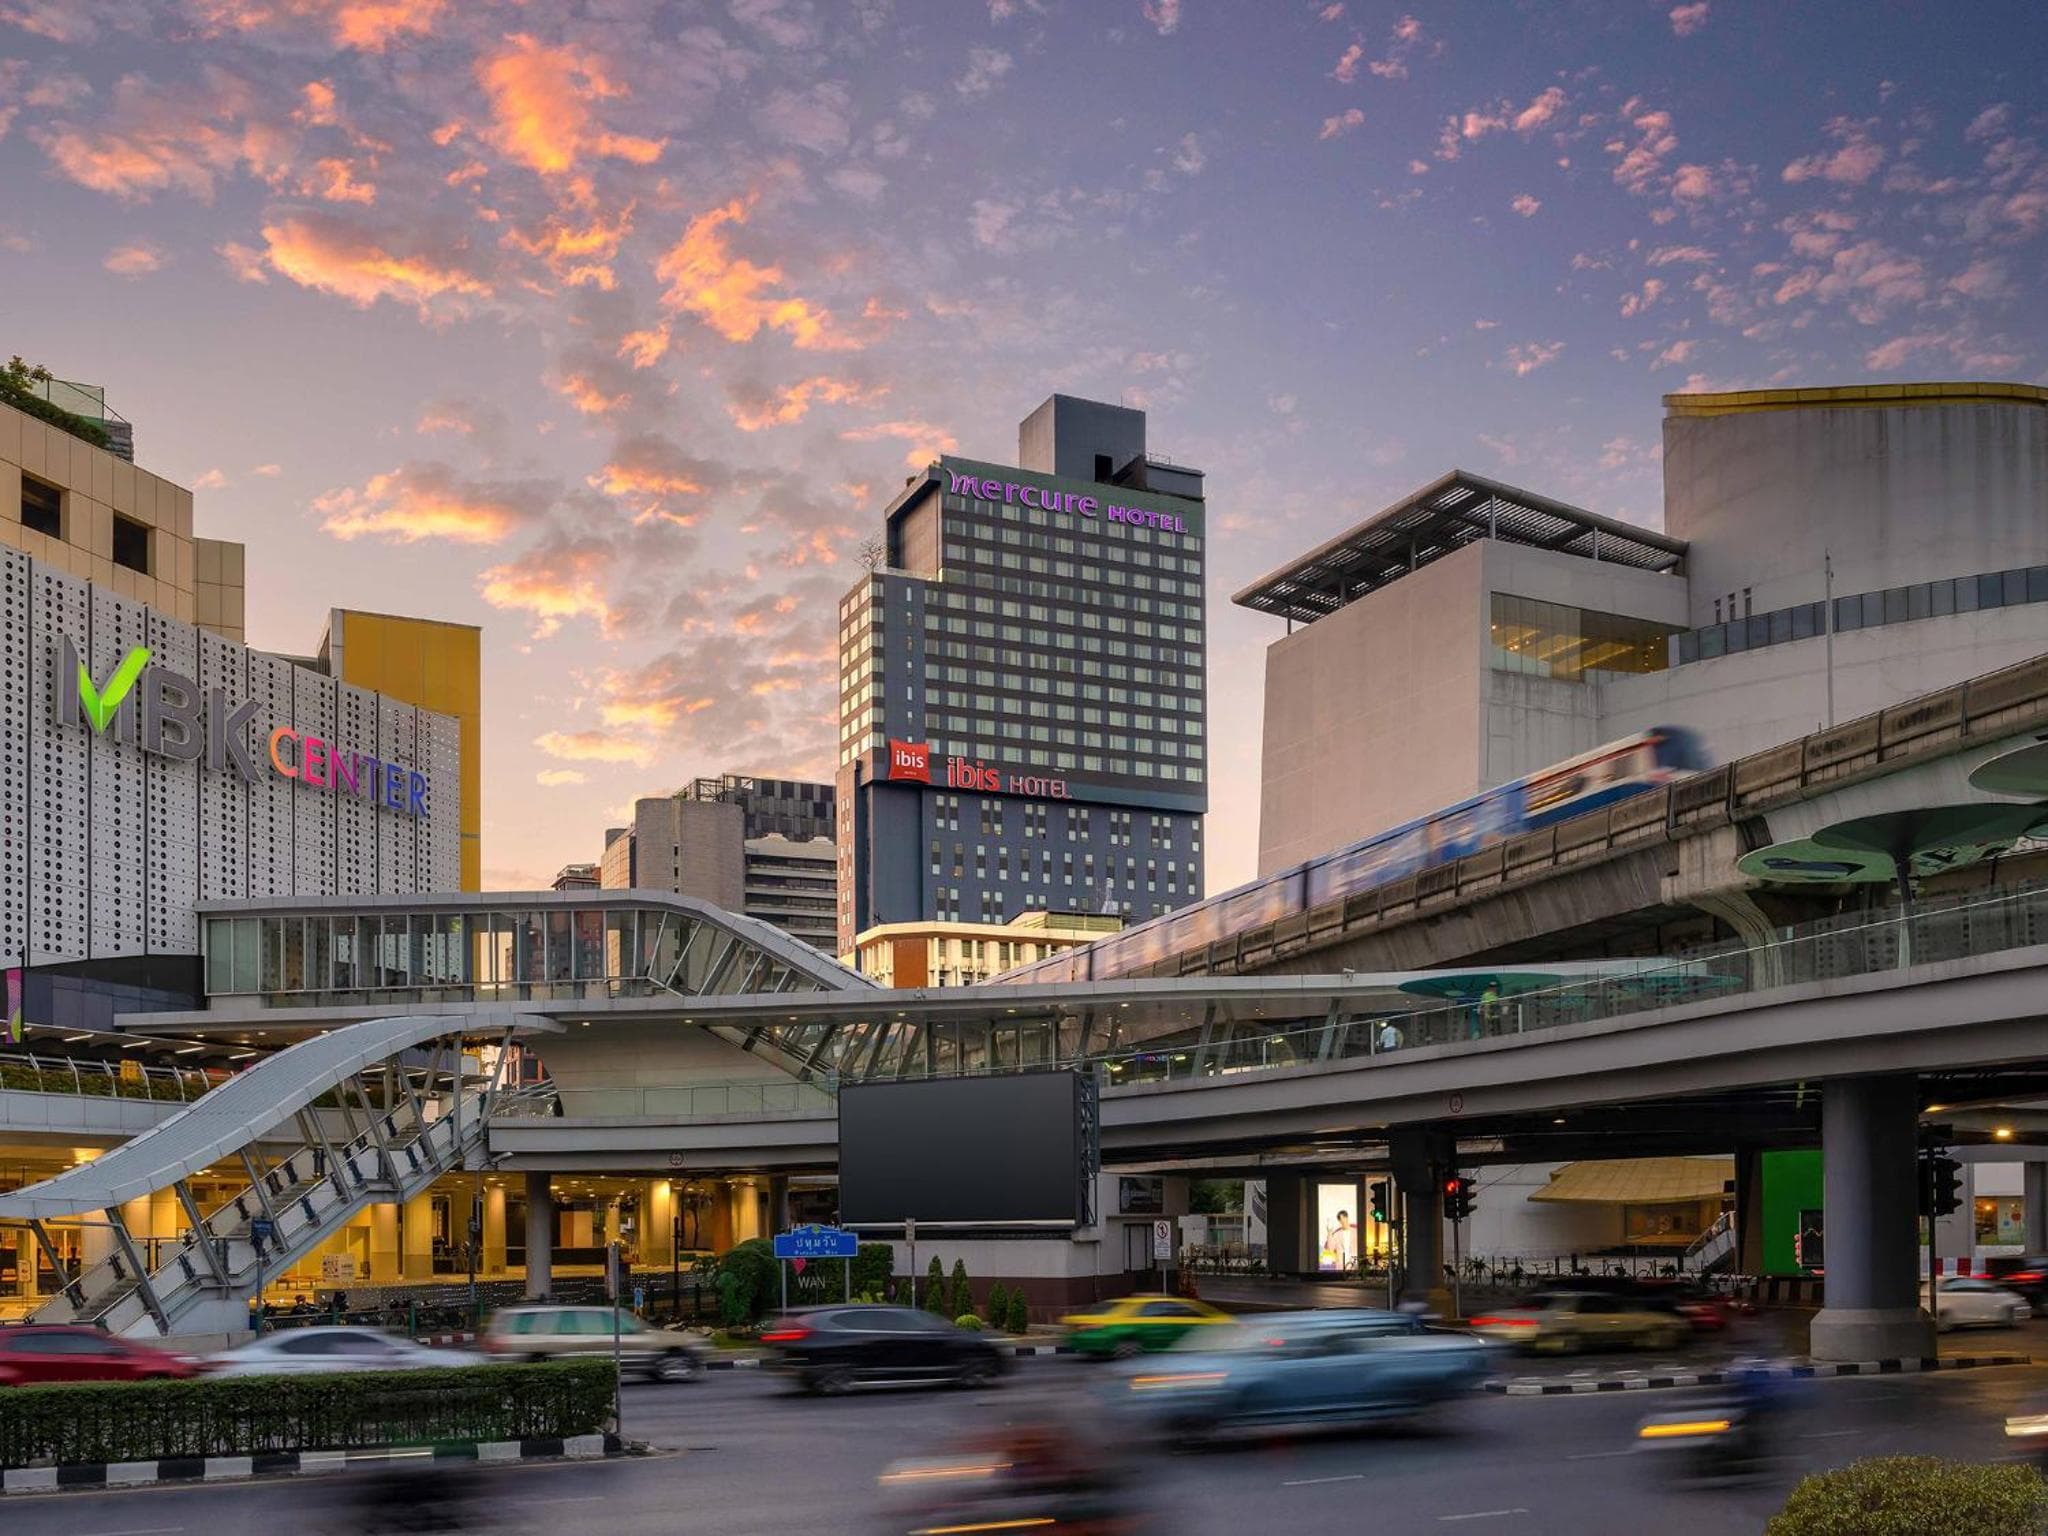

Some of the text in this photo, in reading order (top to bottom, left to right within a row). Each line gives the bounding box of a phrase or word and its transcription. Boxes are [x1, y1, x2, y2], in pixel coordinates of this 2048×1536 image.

[946, 468, 1188, 534] mercure HOTEL
[55, 633, 429, 819] MBK CENTER
[895, 750, 924, 769] ibis
[946, 756, 1073, 799] ibis HOTEL
[798, 1276, 826, 1289] WAN
